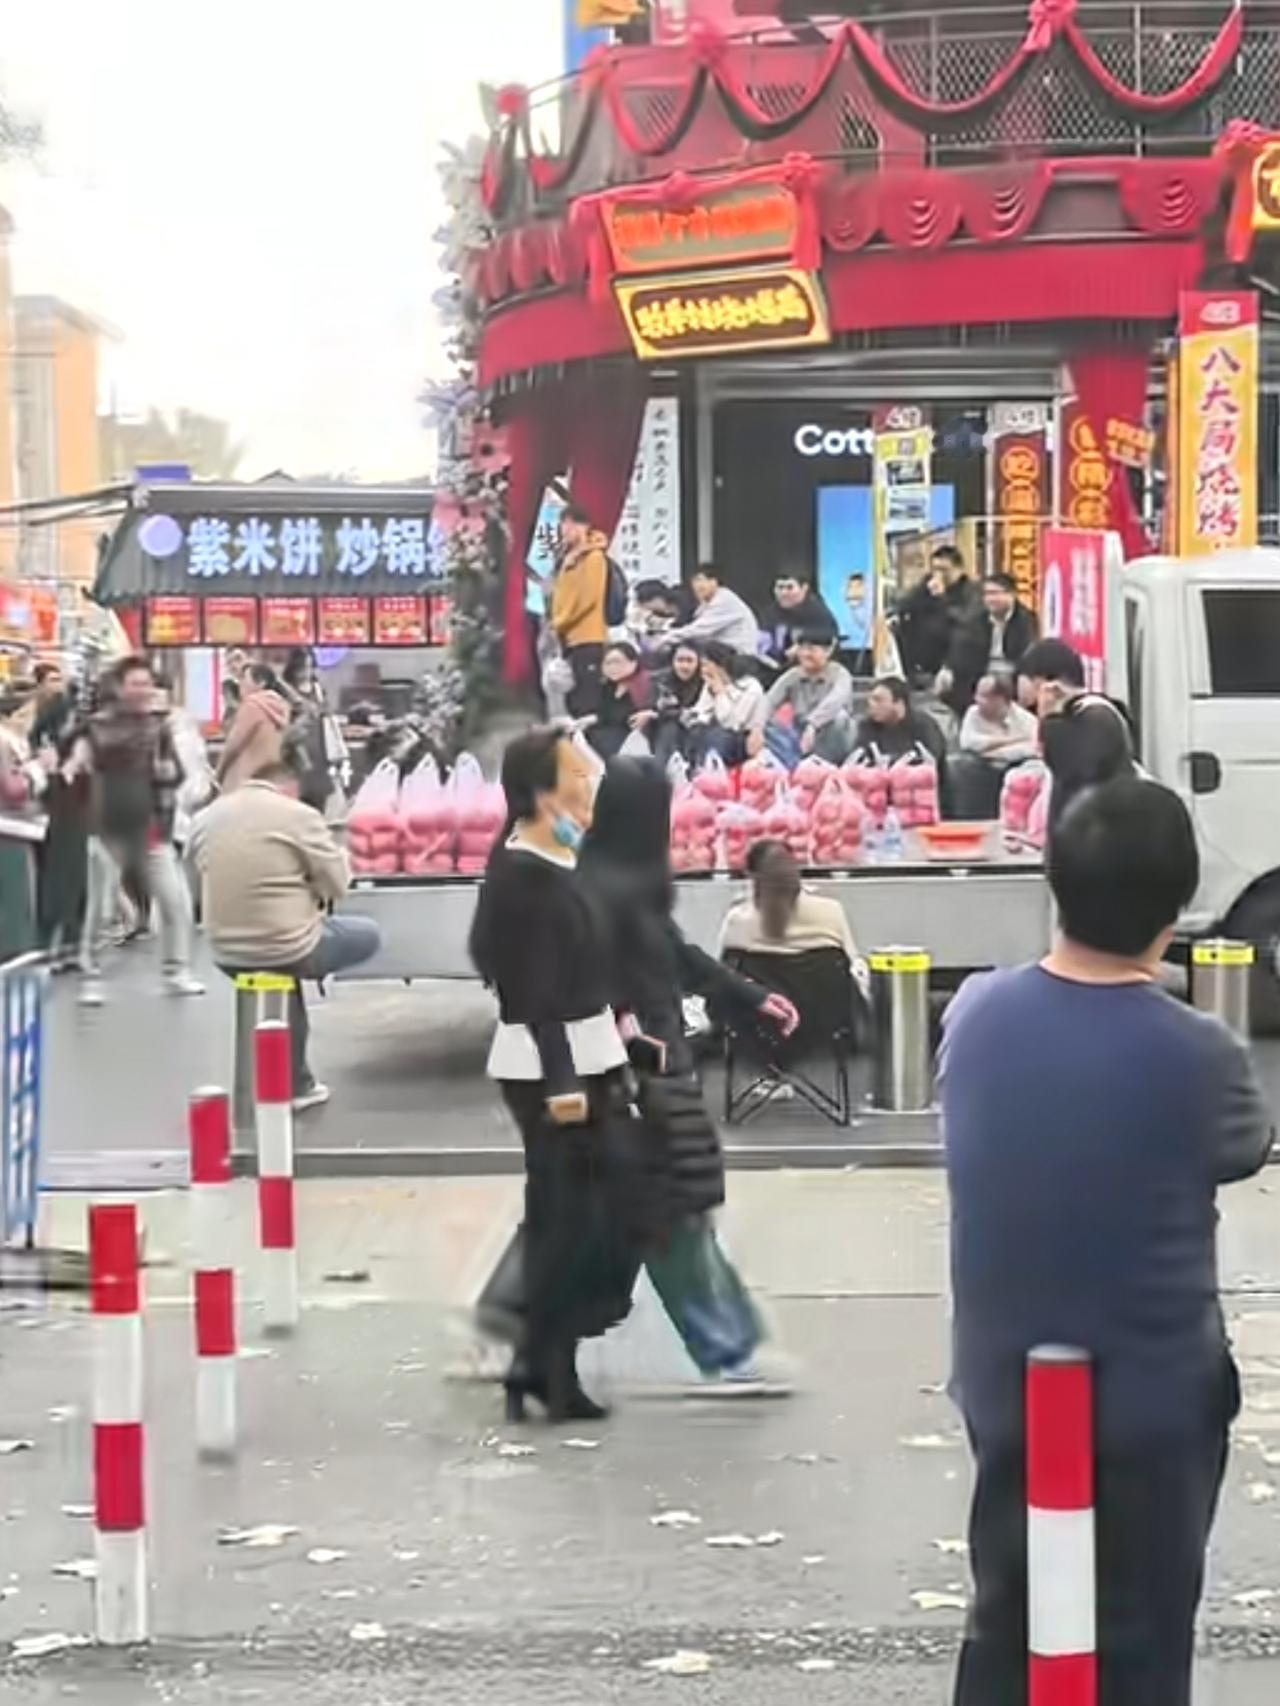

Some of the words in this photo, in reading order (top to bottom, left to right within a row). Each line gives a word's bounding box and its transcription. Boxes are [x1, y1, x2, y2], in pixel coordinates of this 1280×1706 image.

[794, 425, 874, 454] Cott
[1197, 347, 1240, 549] 八大局烧烤
[187, 516, 322, 576] 紫米饼
